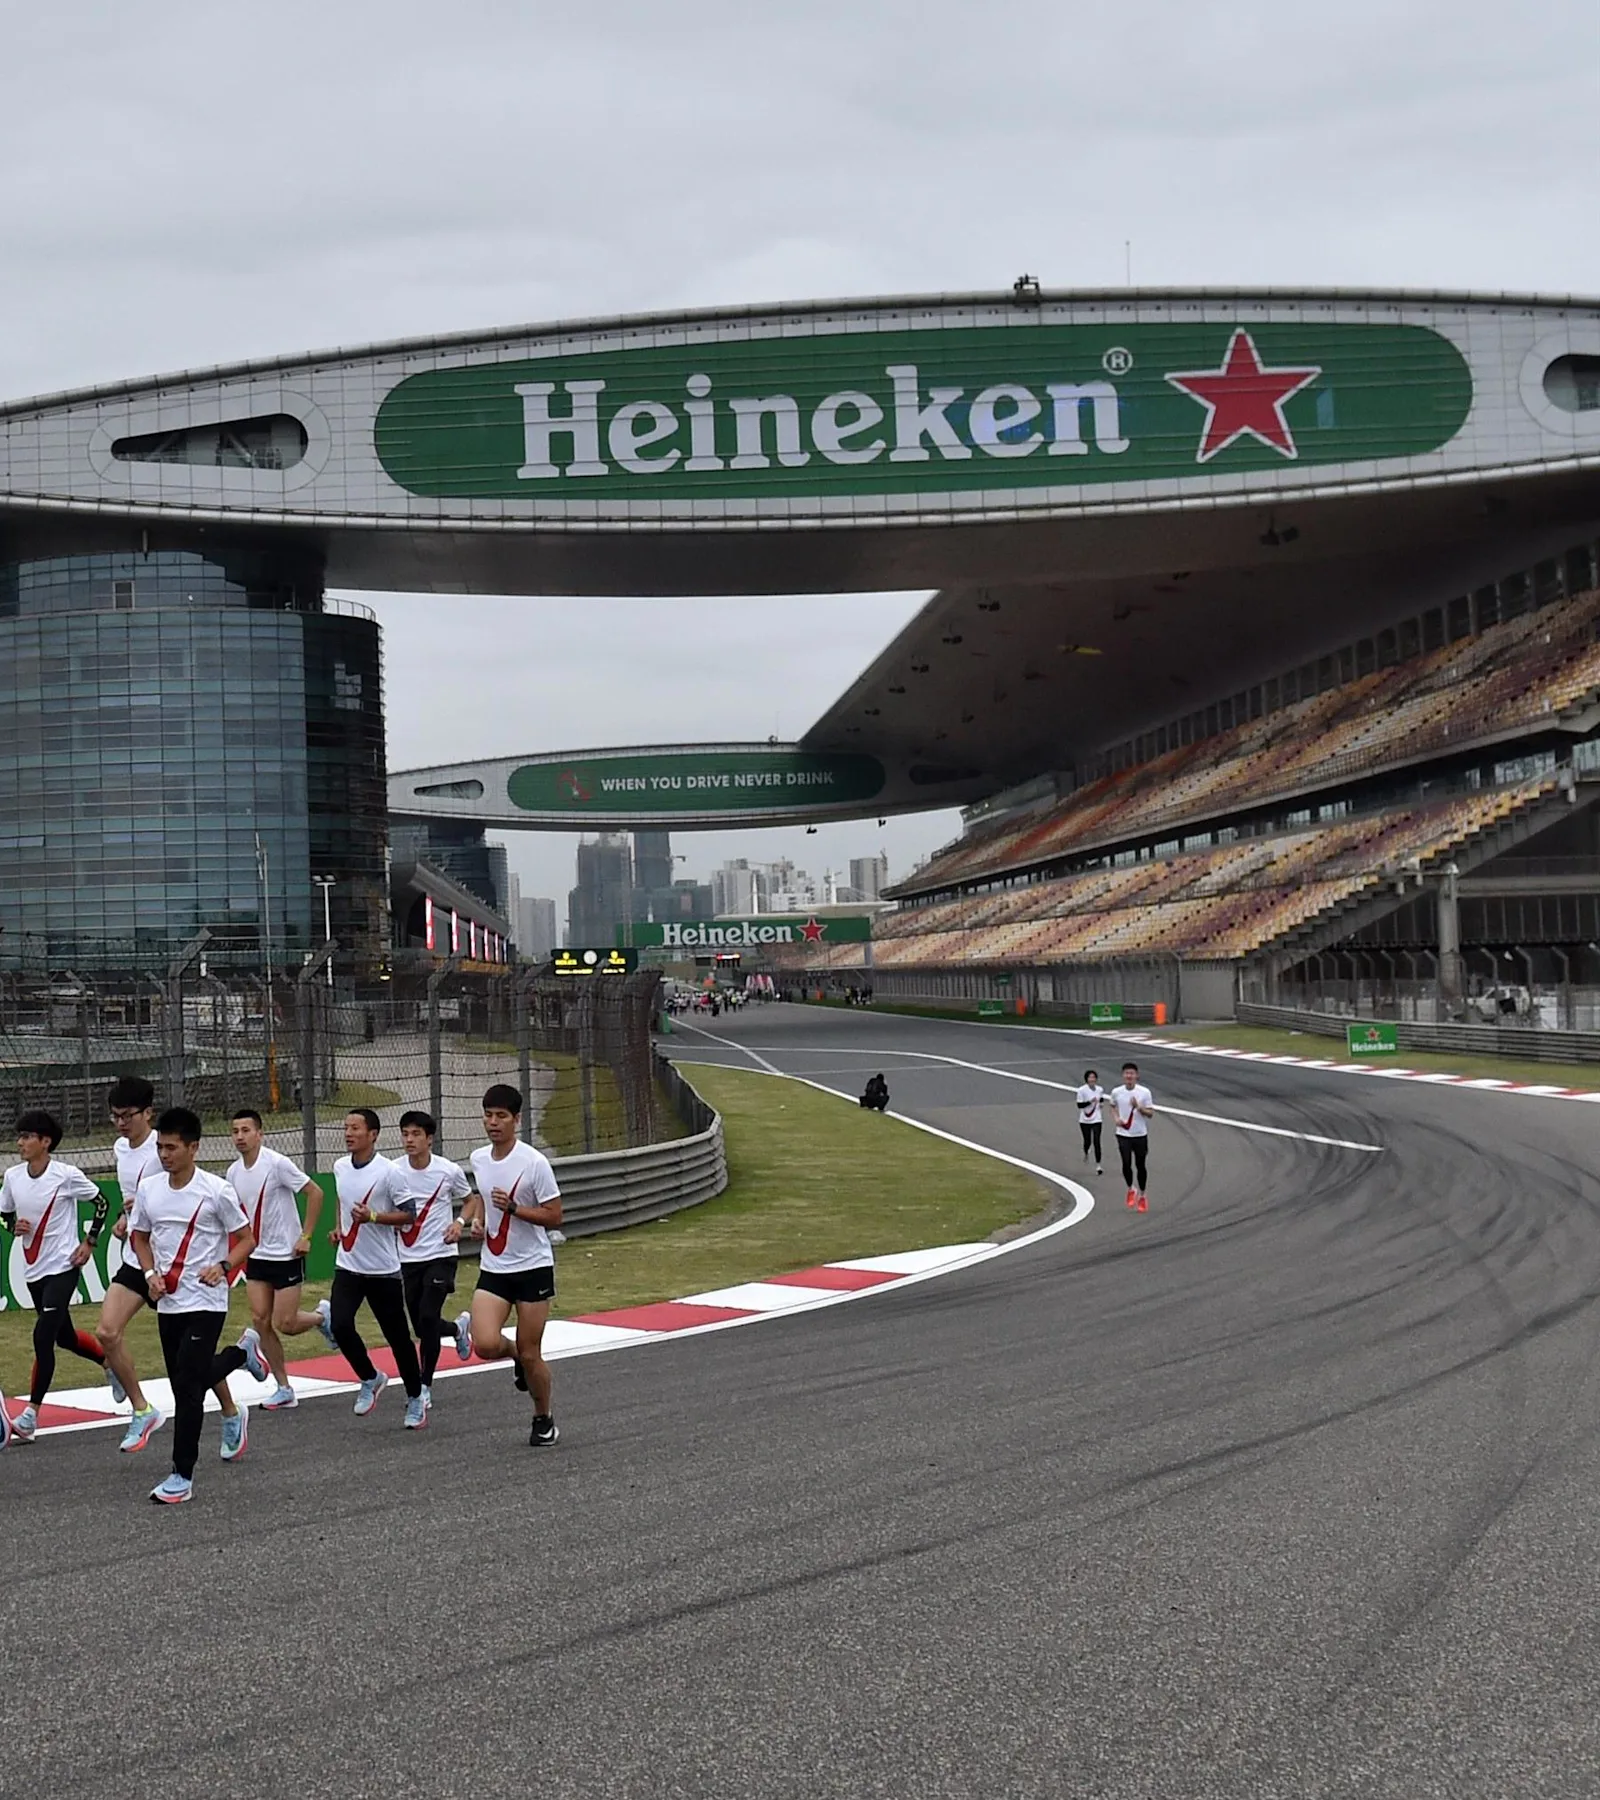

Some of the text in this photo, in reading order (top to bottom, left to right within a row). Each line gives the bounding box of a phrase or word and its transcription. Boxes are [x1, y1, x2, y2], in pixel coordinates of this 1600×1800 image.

[600, 771, 834, 791] WHEN YOU DRIVE NEVER DRINK
[661, 922, 793, 946] Heineken
